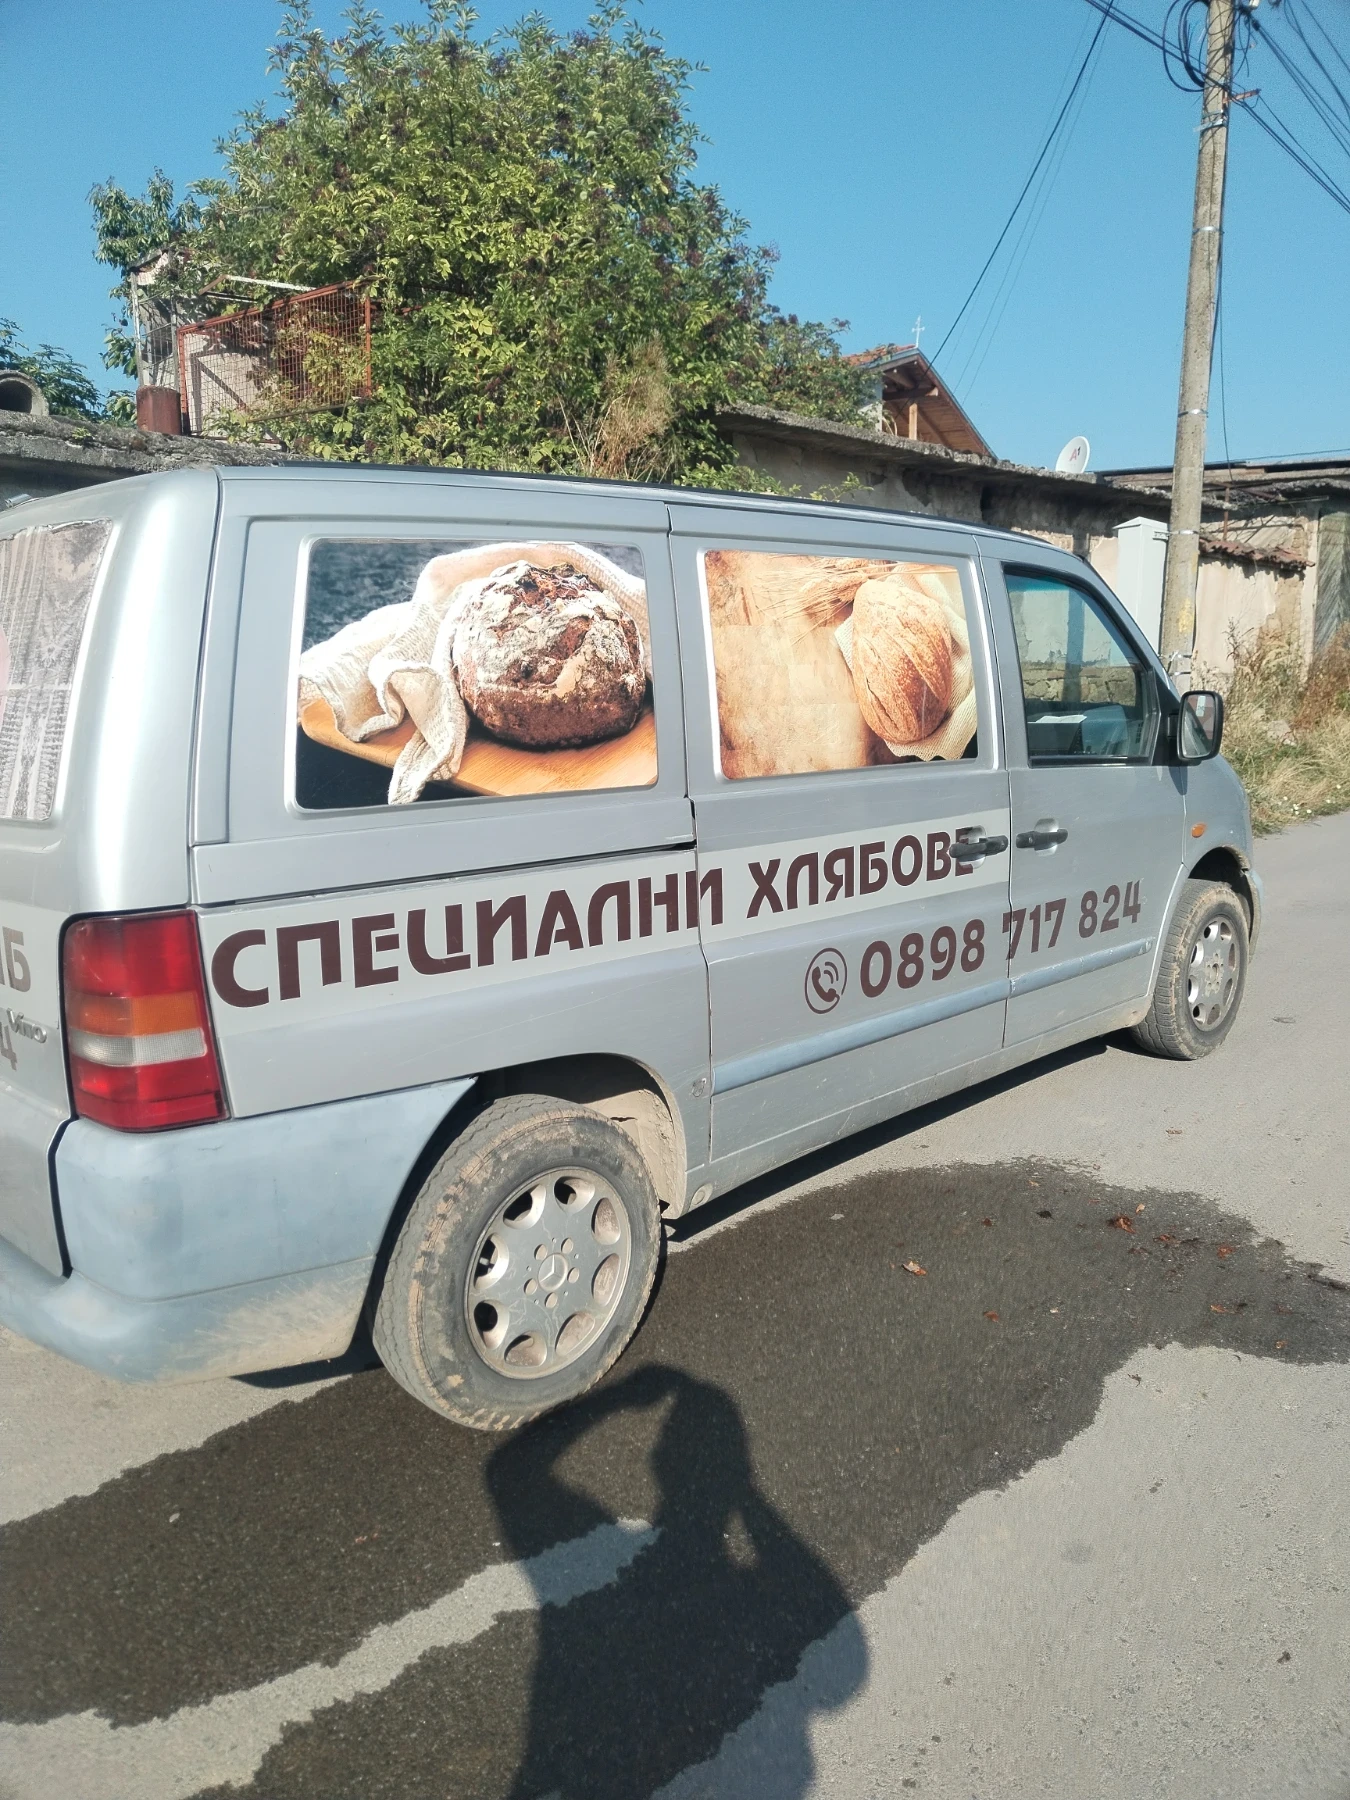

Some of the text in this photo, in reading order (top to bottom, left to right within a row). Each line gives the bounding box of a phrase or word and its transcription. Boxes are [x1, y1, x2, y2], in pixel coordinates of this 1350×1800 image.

[0, 925, 32, 993] Б
[211, 826, 974, 1008] СПЕЦИАЛНИ ХЛЯБОВЕ
[860, 879, 1142, 998] 0898 717 824
